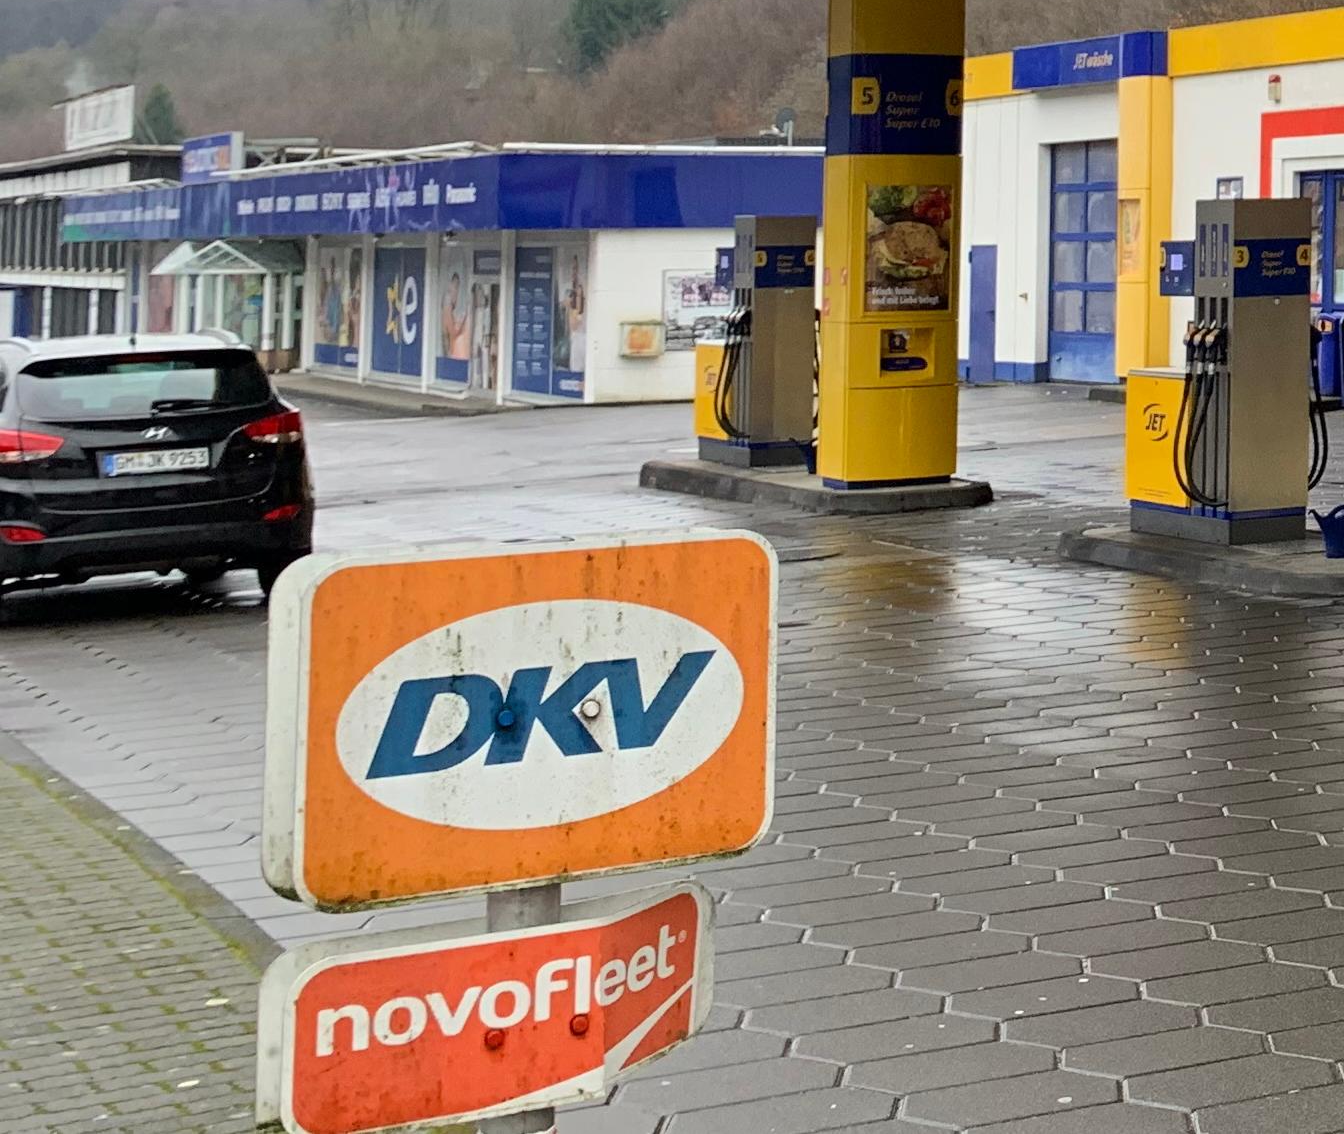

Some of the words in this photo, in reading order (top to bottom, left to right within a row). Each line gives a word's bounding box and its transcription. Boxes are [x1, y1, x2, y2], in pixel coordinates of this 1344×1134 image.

[862, 87, 874, 105] 5
[950, 89, 961, 106] 6
[1237, 249, 1245, 264] 3
[1300, 248, 1309, 261] 4
[1145, 413, 1166, 432] JET
[364, 649, 718, 780] DKV
